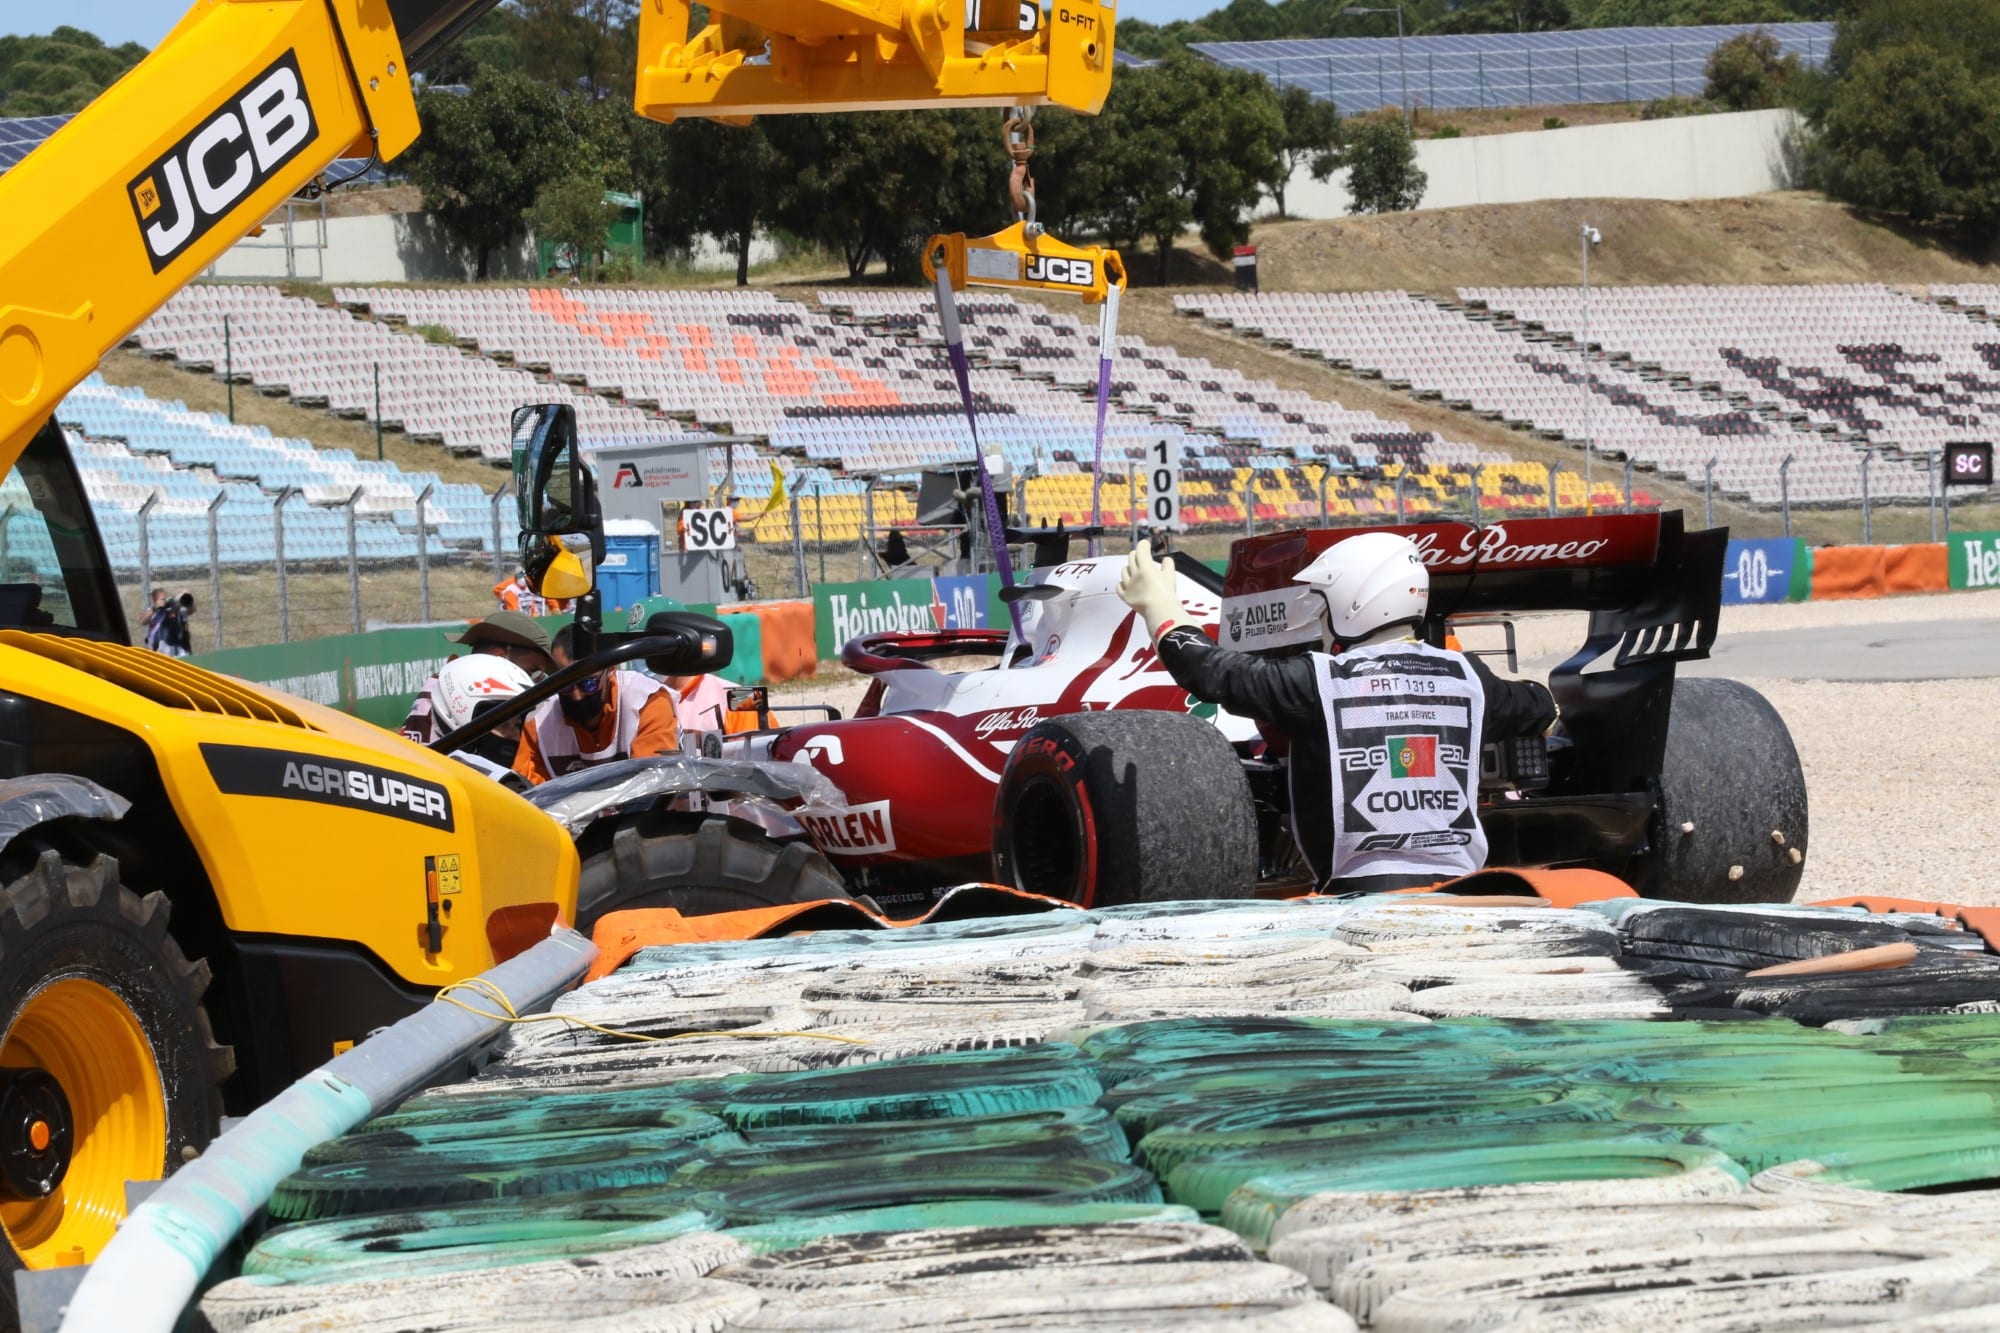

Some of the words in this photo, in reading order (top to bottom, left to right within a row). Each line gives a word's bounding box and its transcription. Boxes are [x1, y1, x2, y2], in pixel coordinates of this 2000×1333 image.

[1060, 9, 1095, 31] Q-FIT
[146, 66, 310, 257] JCB
[1027, 257, 1092, 285] JCB
[1956, 454, 1981, 472] SC
[691, 511, 727, 547] SC
[1451, 524, 1608, 565] Romeo
[1245, 601, 1287, 626] ADLER
[381, 662, 403, 696] YOU
[1371, 678, 1400, 693] PRT
[974, 710, 1015, 740] Alfa
[1385, 710, 1410, 721] TRACK
[1411, 709, 1437, 720] SERVICE
[1367, 789, 1459, 813] COURSE
